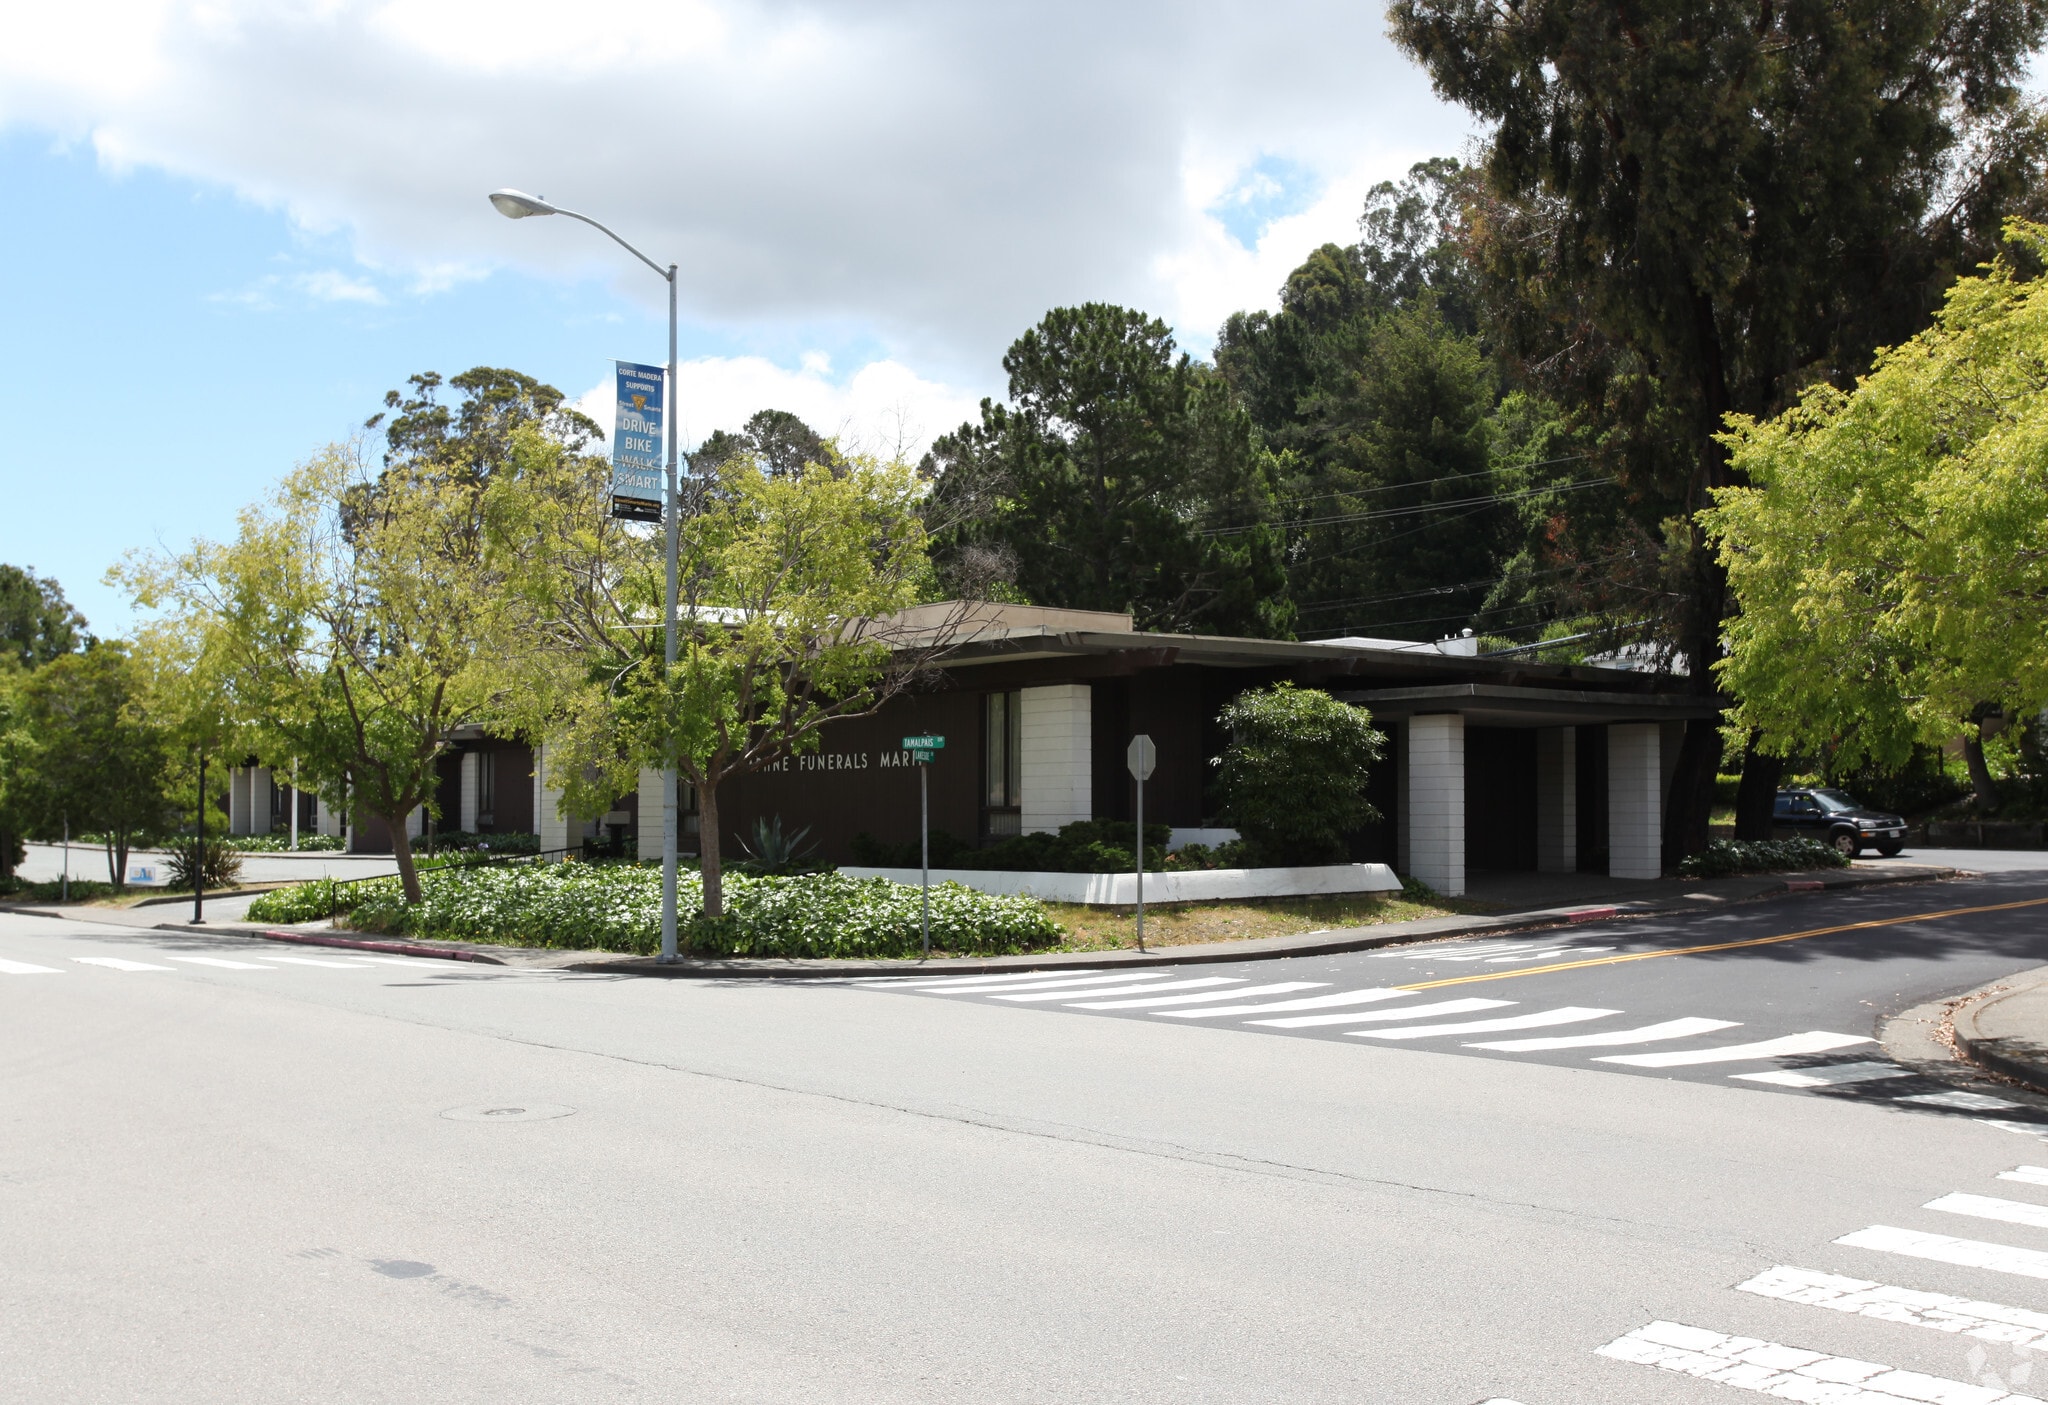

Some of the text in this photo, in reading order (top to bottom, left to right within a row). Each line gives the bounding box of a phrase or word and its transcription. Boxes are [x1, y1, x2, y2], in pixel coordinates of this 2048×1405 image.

[618, 368, 662, 382] CORTE MADERA
[625, 381, 655, 393] SUPPORTS
[622, 417, 657, 435] DRIVE
[625, 436, 652, 453] BIKE
[621, 455, 655, 472] WALK
[617, 472, 658, 490] SMART
[904, 738, 934, 748] TAMALPAIS
[800, 753, 868, 771] FUNERALS
[880, 749, 922, 768] MARI
